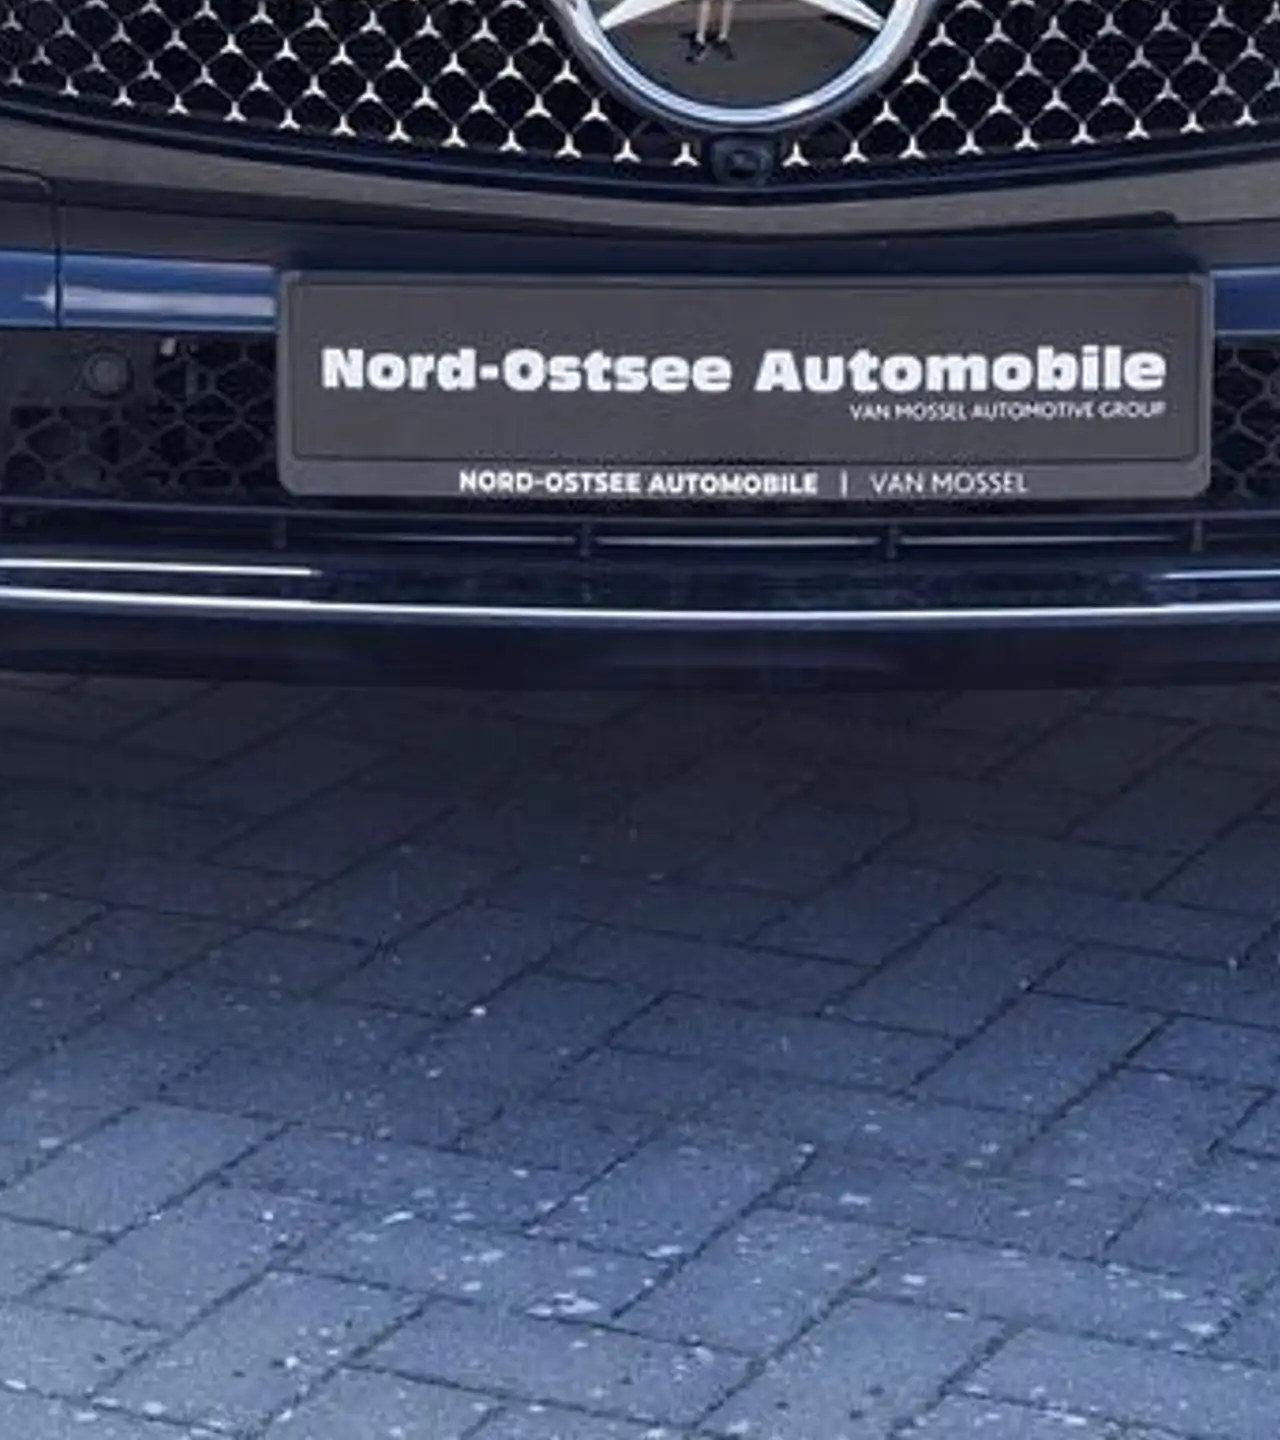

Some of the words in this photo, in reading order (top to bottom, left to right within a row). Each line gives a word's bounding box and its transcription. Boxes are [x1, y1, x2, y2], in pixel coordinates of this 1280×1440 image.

[322, 347, 732, 392] Nord-Ostsee
[754, 345, 1167, 392] Automobile
[849, 403, 890, 421] VAN
[894, 402, 967, 421] MOSSEL
[970, 401, 1095, 420] AUTOMOTIVE
[1098, 401, 1167, 419] GROUP
[458, 470, 641, 494] NORD-OSTSEE
[647, 471, 819, 495] AUTOMOBILE
[869, 471, 923, 494] VAN
[931, 471, 1028, 495] MOSSEL
